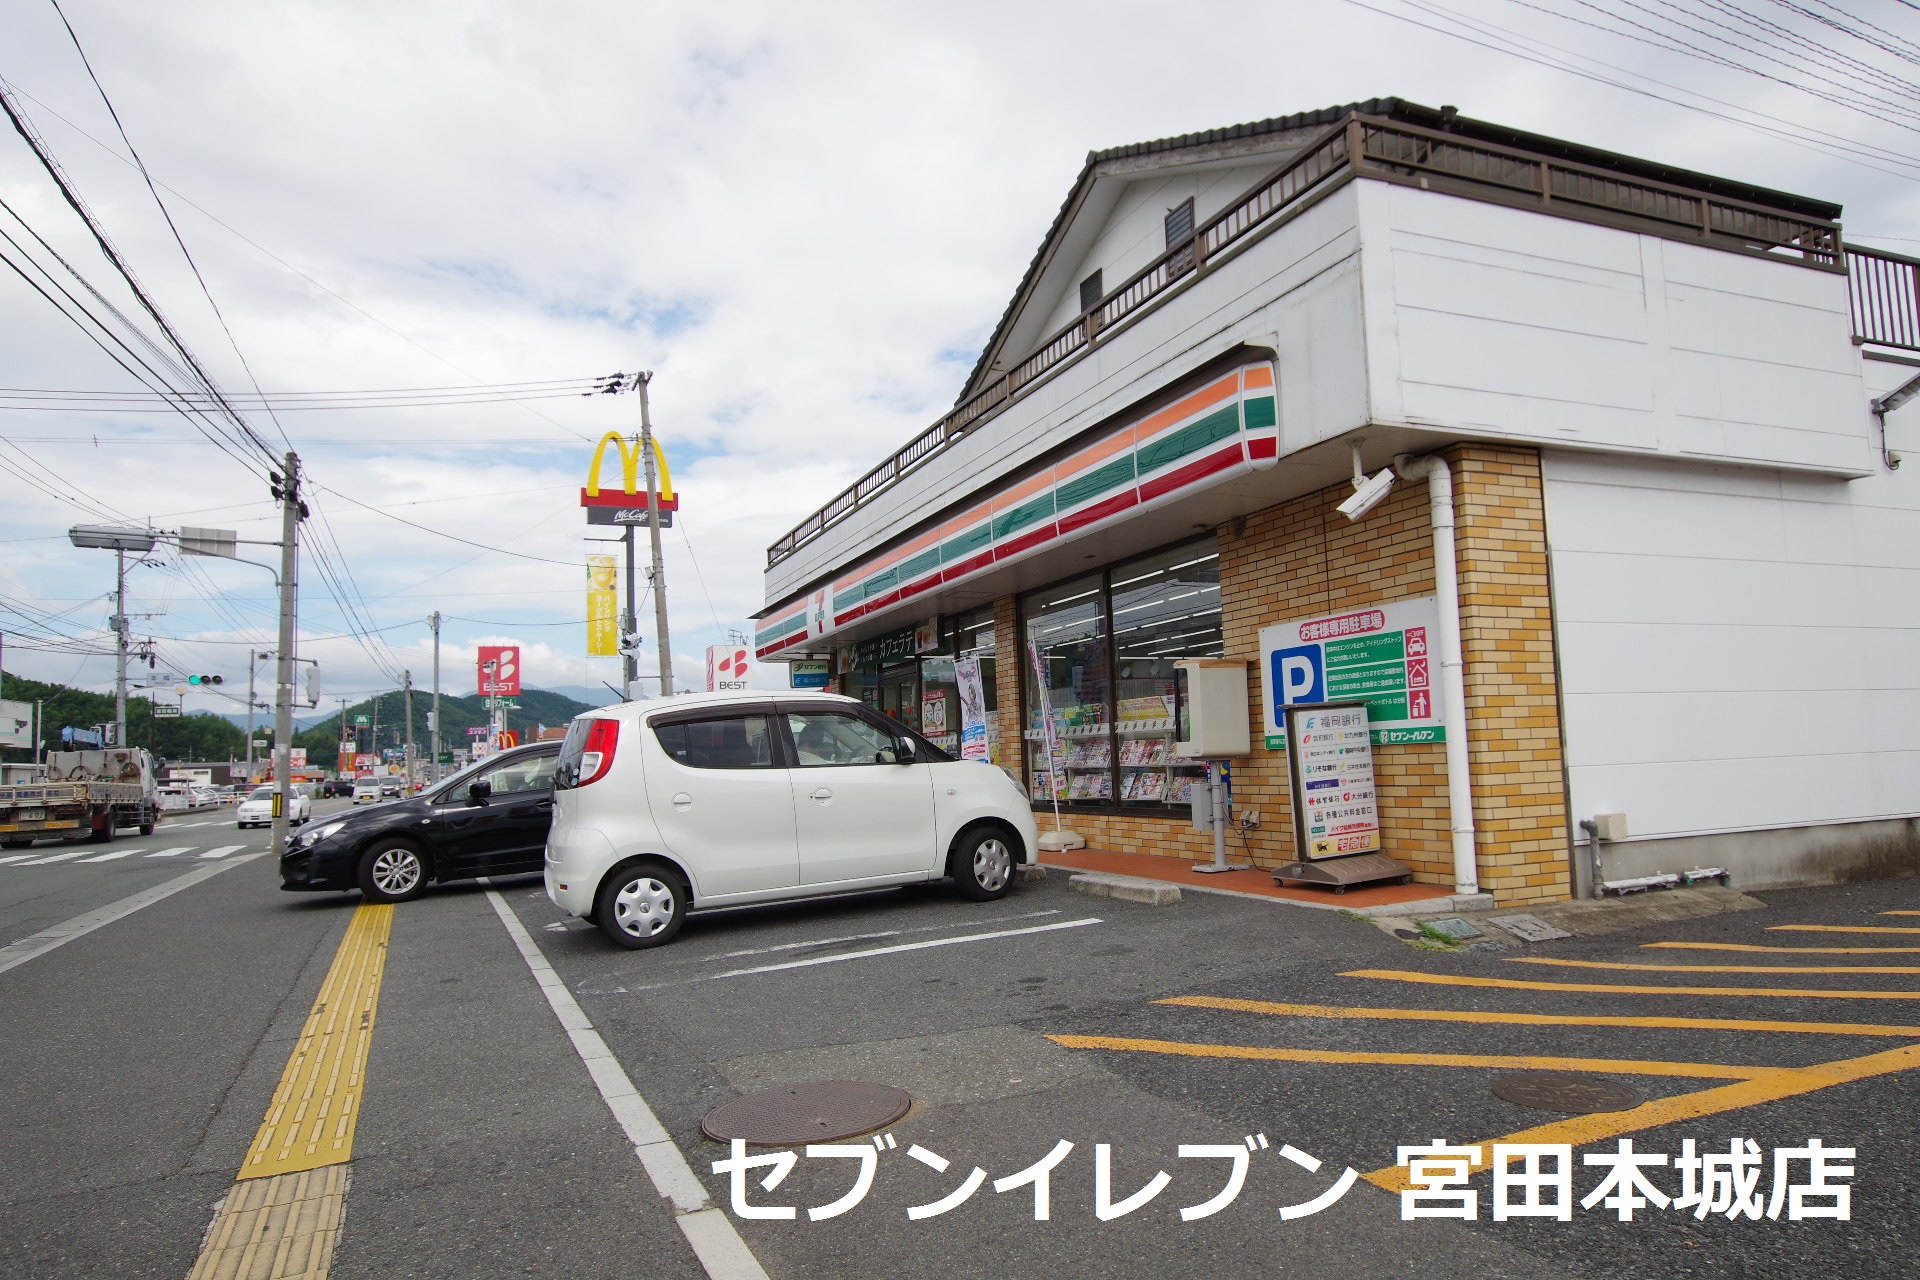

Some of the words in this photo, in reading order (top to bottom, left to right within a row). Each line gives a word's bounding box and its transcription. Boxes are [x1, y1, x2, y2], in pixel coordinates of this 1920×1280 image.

[1301, 612, 1383, 640] お客様専用駐車場
[880, 631, 913, 658] カフェラテ
[720, 681, 747, 690] BEST
[1282, 656, 1314, 706] P
[1320, 714, 1361, 728] 福岡銀行
[1313, 764, 1337, 772] りそな銀行
[1352, 791, 1374, 801] 大分銀行
[1325, 806, 1373, 820] 各種公共料金窓口
[1338, 836, 1371, 850] 宅急便
